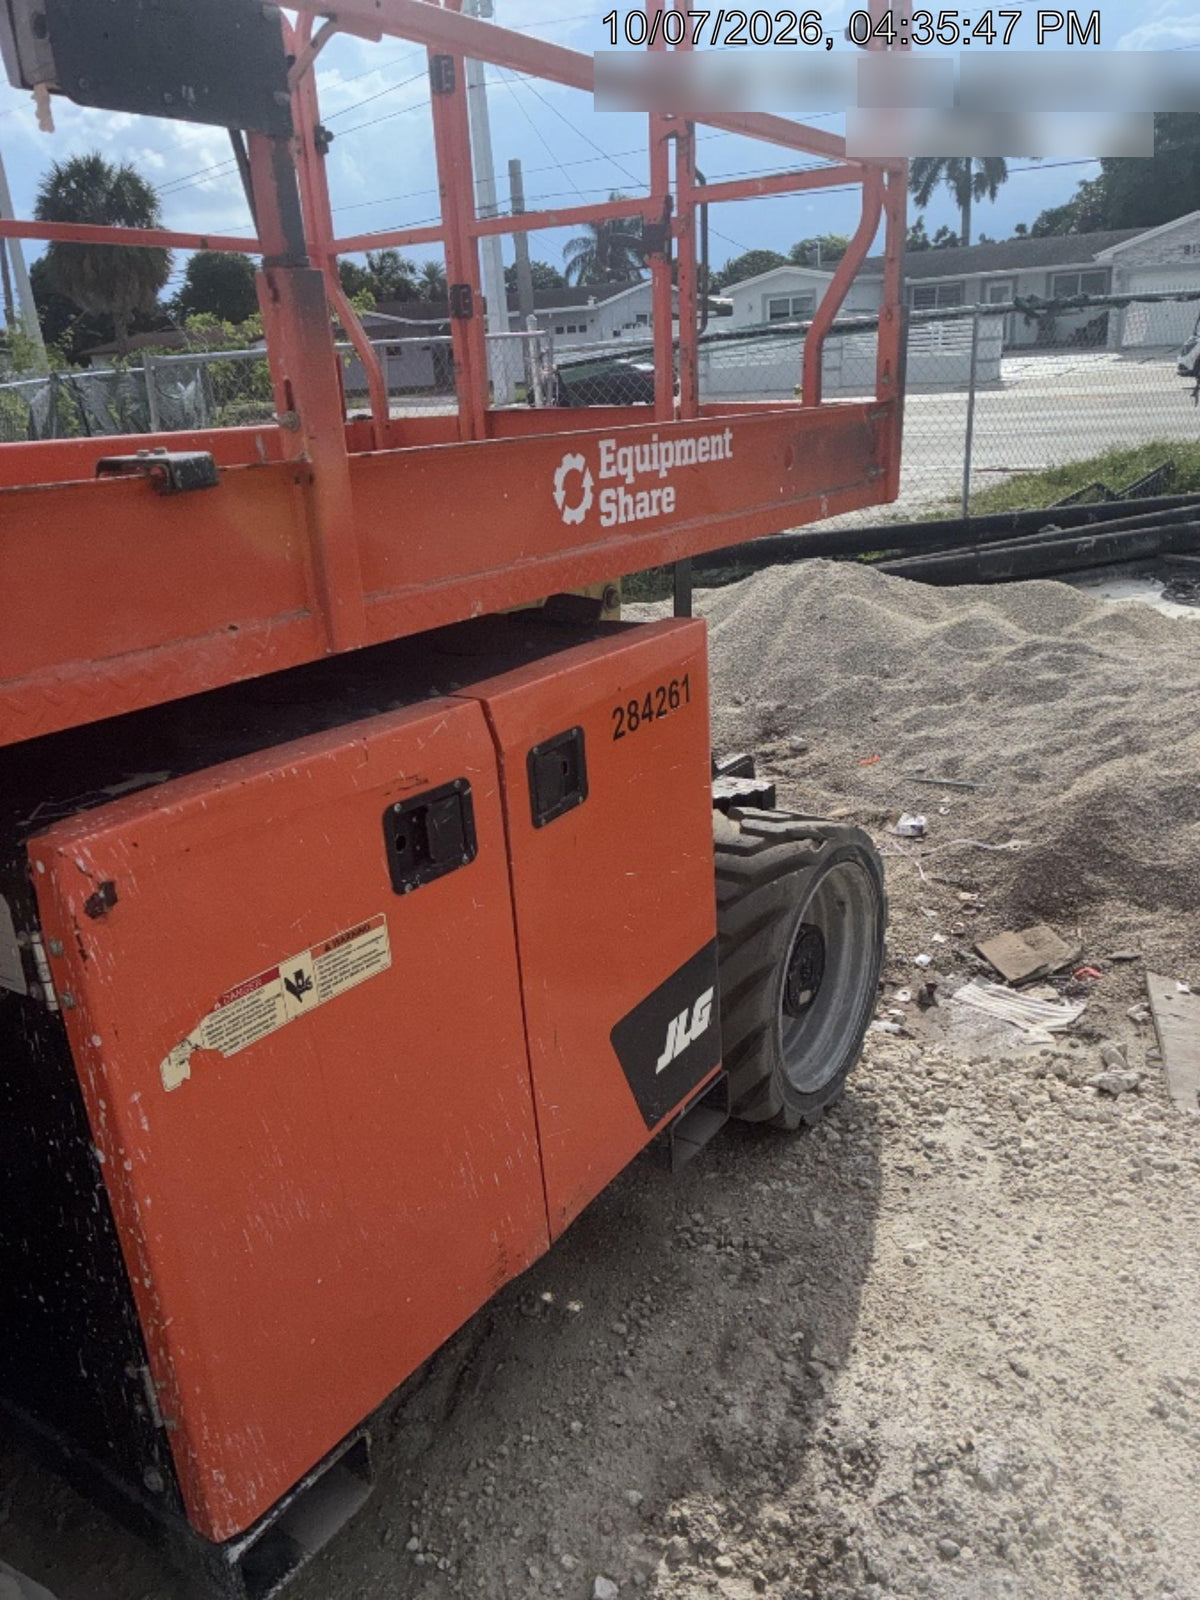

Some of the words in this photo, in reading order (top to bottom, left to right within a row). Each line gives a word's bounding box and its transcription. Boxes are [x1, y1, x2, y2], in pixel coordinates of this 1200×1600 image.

[598, 427, 733, 484] Equipment
[600, 485, 676, 527] Share
[612, 673, 690, 740] 284261
[655, 986, 714, 1075] JLG
